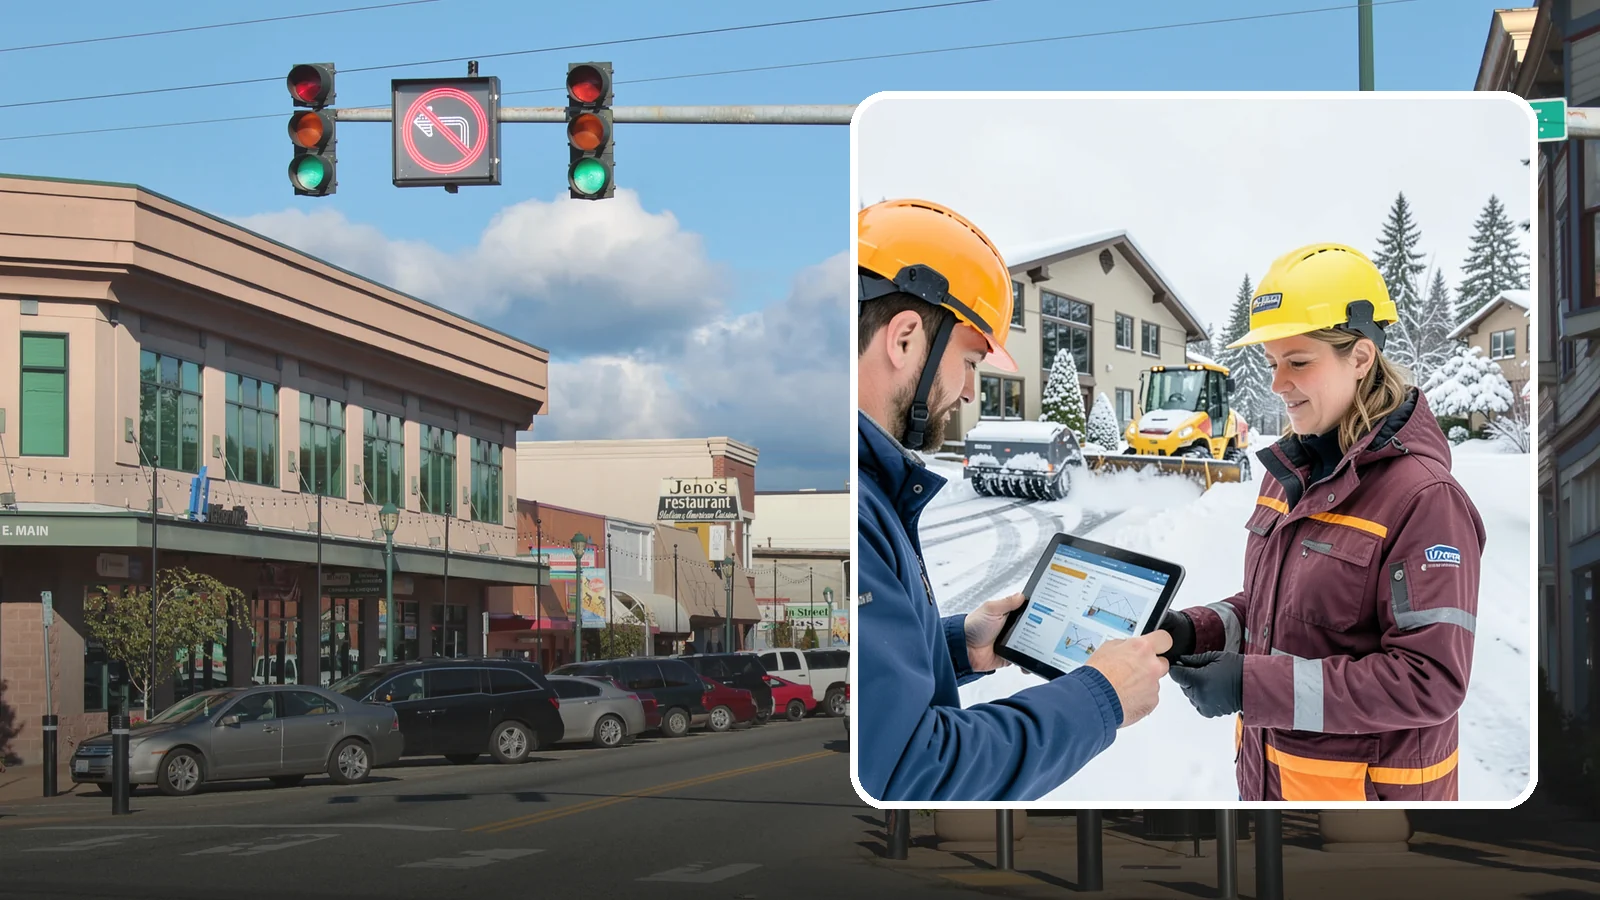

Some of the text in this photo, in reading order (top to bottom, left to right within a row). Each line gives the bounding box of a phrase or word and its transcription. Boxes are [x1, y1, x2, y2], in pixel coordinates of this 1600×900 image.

[670, 480, 727, 494] Jeno's
[665, 496, 731, 509] restaurant
[659, 510, 681, 519] Italian
[686, 509, 714, 519] American
[715, 509, 738, 519] Cuisine
[2, 525, 49, 536] E. MAIN
[797, 607, 828, 616] Street
